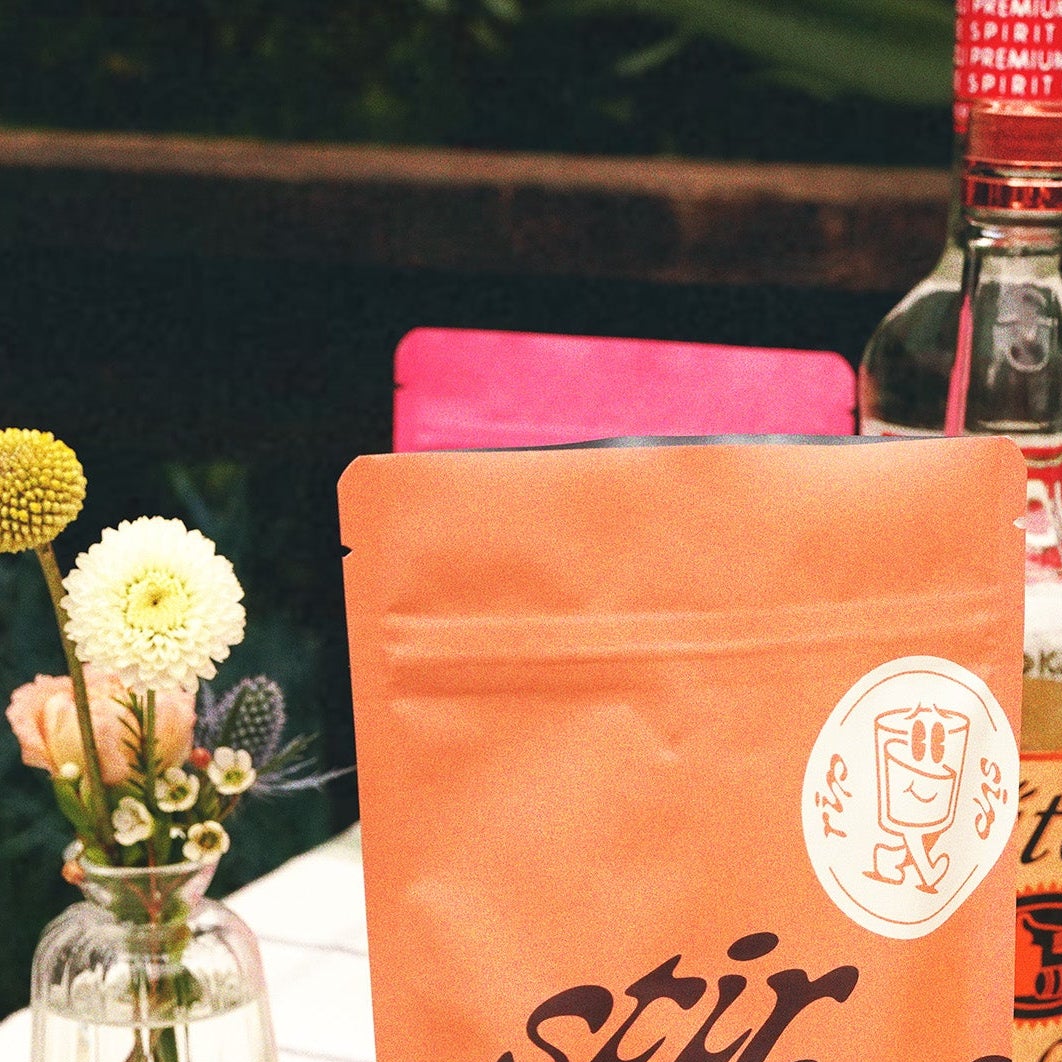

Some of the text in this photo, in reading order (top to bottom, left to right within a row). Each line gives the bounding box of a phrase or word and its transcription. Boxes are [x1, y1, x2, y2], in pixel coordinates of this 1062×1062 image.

[969, 20, 1055, 44] SPIRIT
[967, 72, 1054, 96] SPIRIT
[815, 754, 852, 838] rip
[973, 757, 1008, 840] sip
